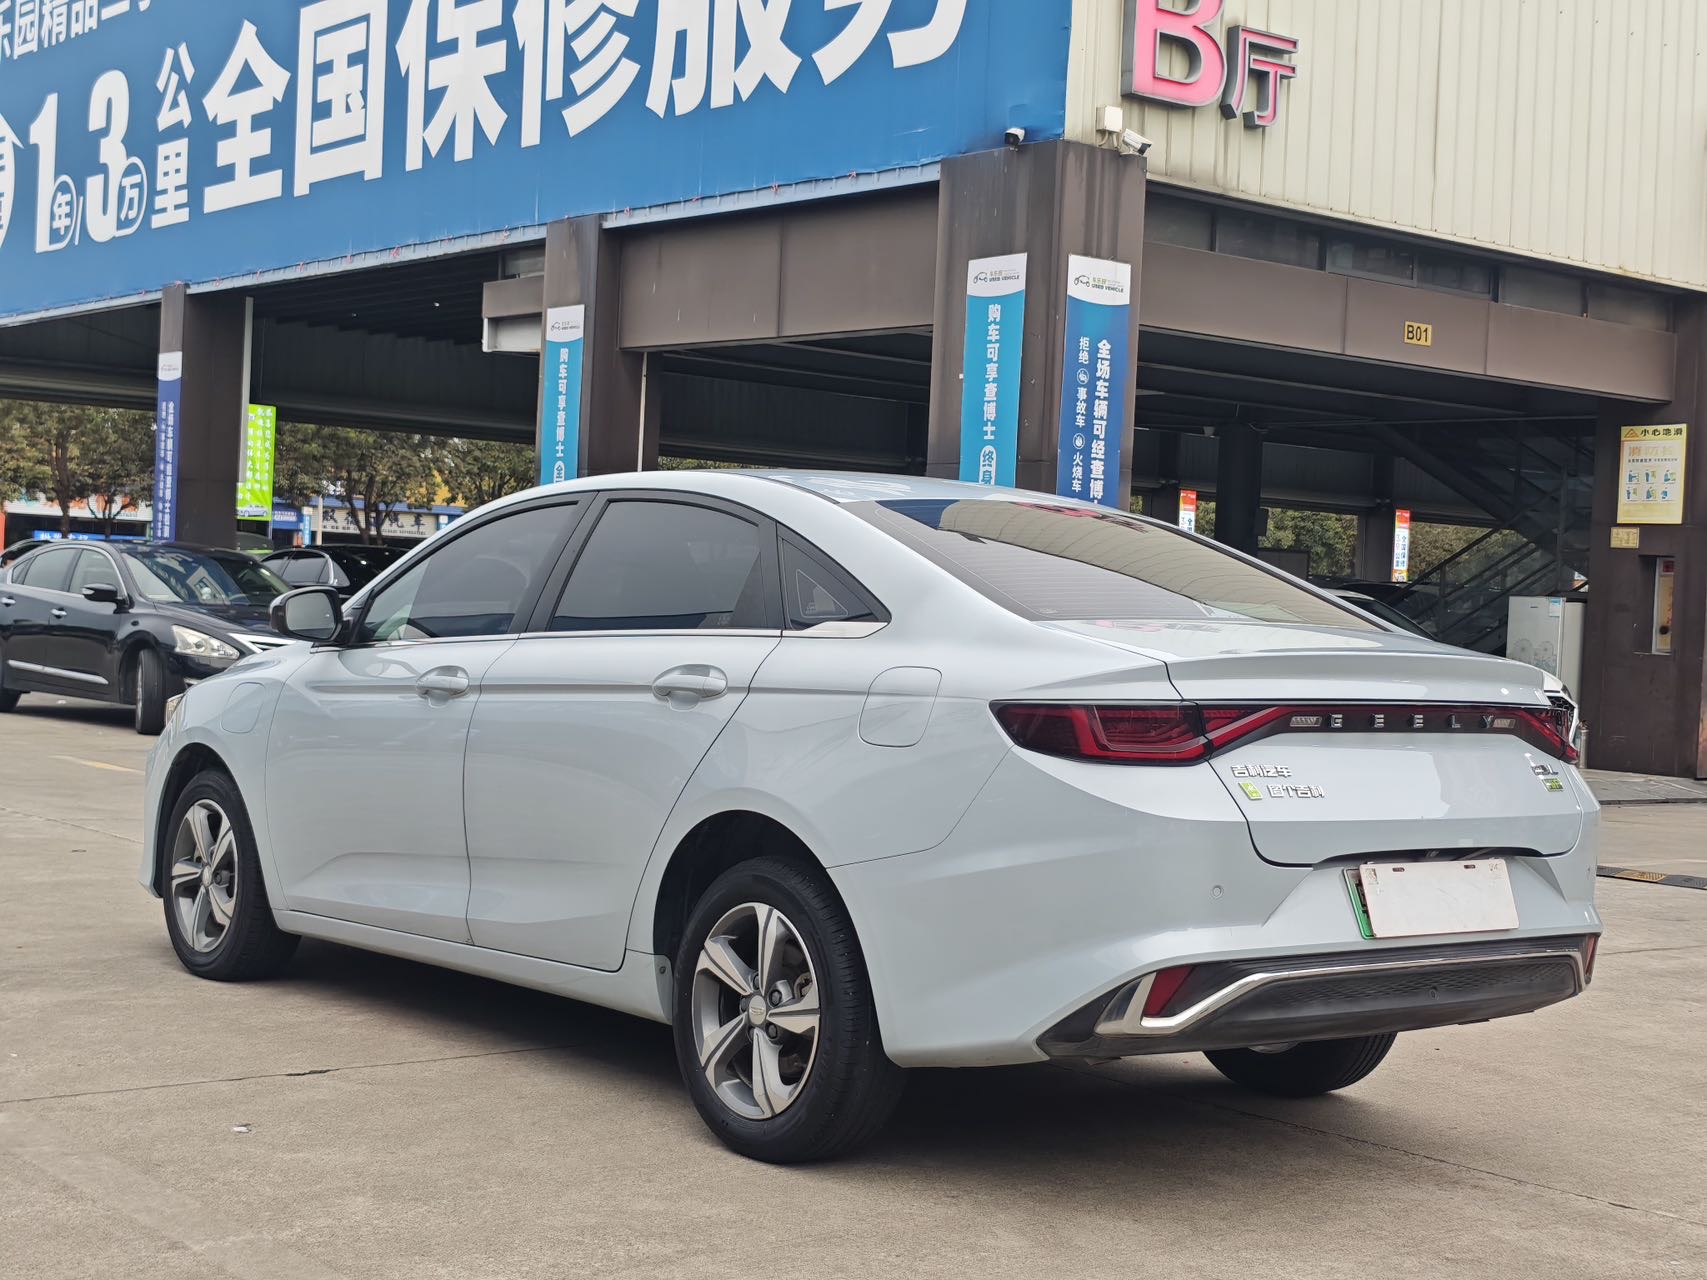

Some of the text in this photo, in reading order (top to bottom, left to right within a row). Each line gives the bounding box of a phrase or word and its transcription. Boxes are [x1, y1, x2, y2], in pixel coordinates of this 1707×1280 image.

[1121, 0, 1299, 129] B厅
[1407, 324, 1428, 342] B01
[983, 303, 1001, 440] 购车可享查博士
[1072, 337, 1090, 493] 拒绝 事故车 火烧车
[1090, 339, 1112, 504] 全场车辆可经查博
[1640, 428, 1683, 437] 小心地滑
[1329, 713, 1494, 729] GEELY
[1231, 764, 1292, 778] 吉利汽车
